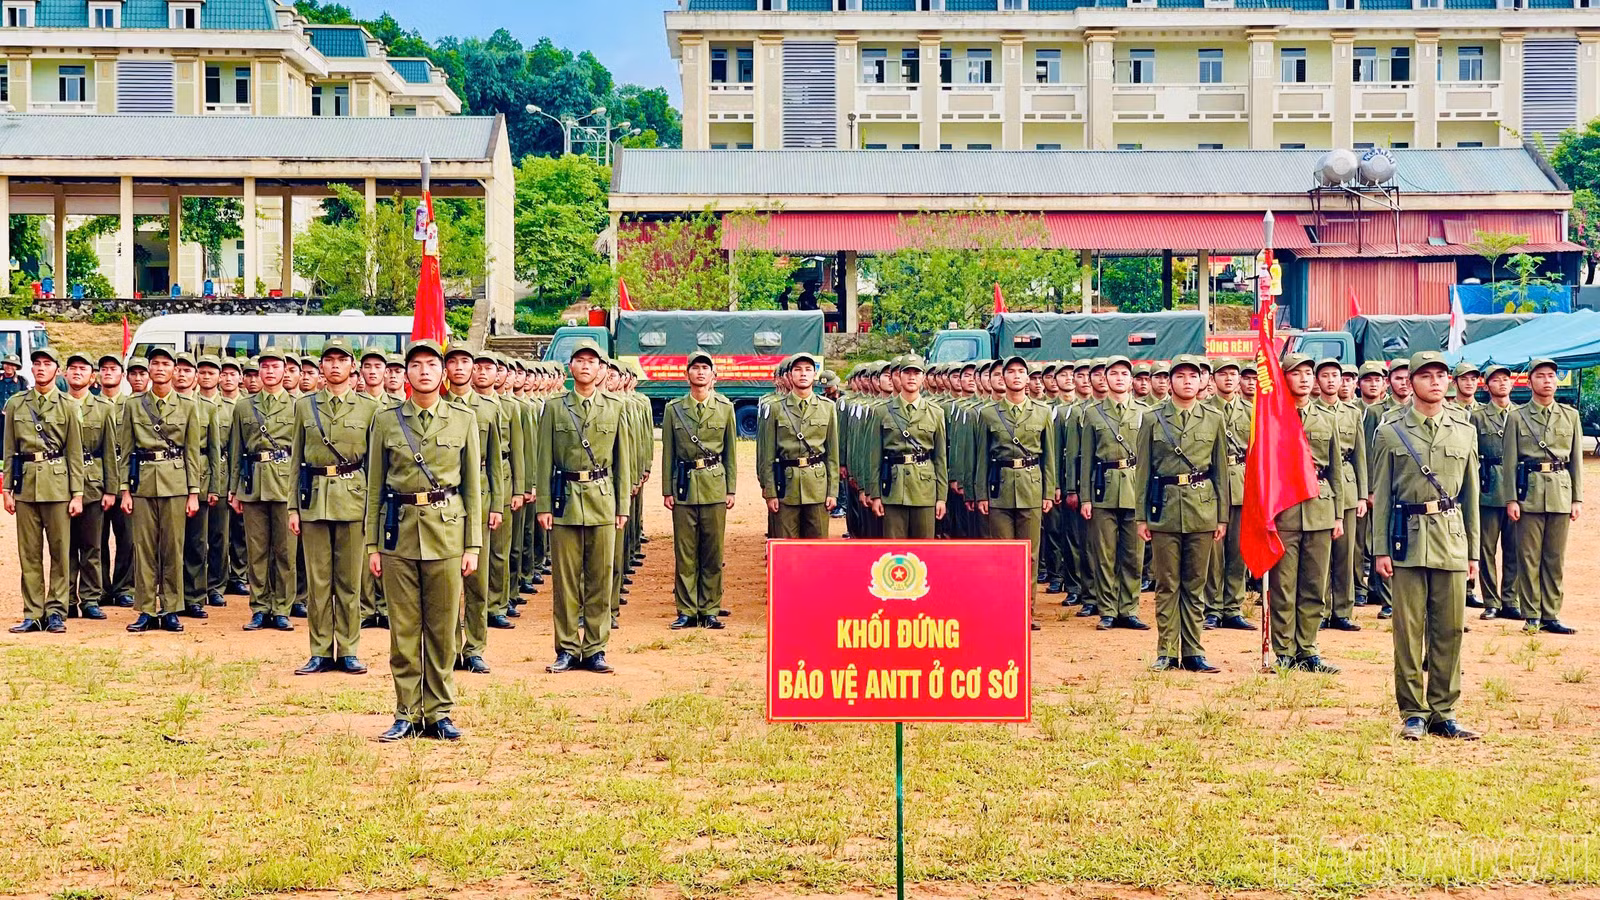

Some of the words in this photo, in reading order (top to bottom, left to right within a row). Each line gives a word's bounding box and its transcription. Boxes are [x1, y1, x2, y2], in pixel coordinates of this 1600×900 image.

[837, 609, 890, 648] KHỐI
[897, 613, 960, 648] ĐỨNG
[778, 660, 824, 698] BẢO
[831, 664, 858, 705] VỆ
[865, 669, 922, 698] ANTT
[929, 660, 945, 698] Ở
[951, 667, 981, 698] CƠ
[988, 660, 1019, 698] SỞ
